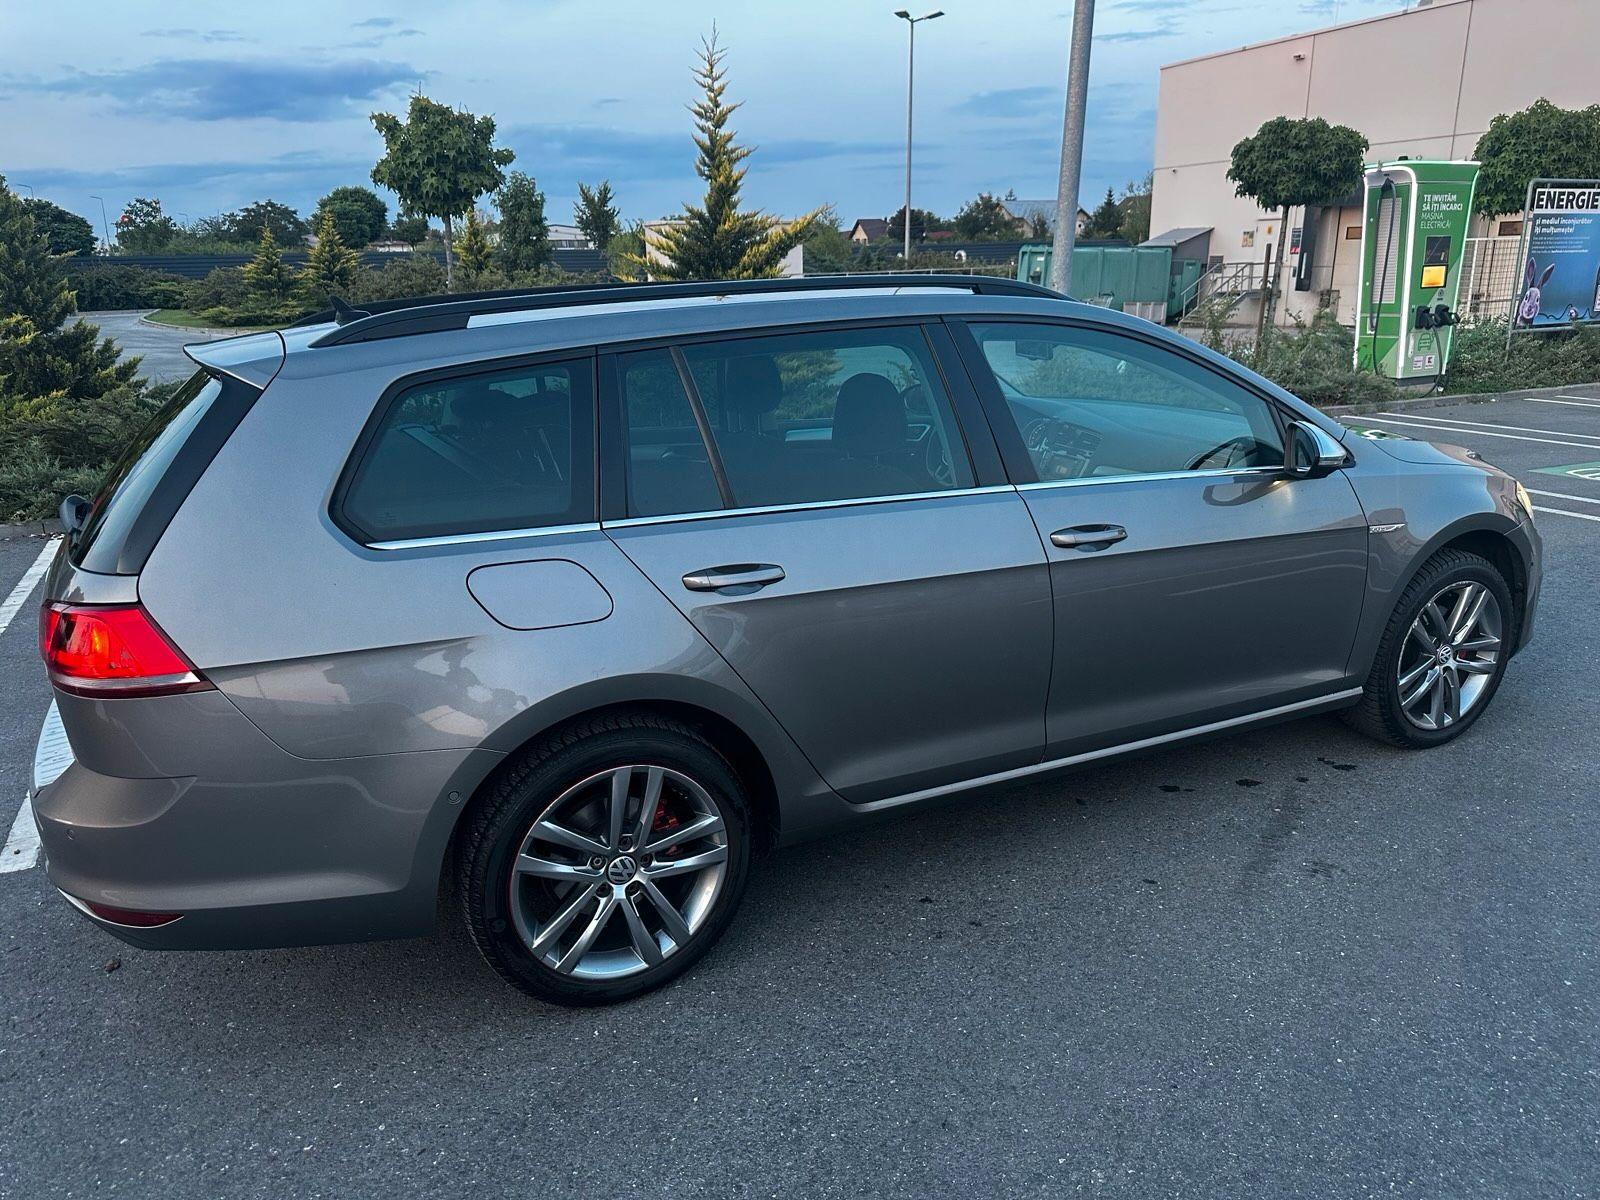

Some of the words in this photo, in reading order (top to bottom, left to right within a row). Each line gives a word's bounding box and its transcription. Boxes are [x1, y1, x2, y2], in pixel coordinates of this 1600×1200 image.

[1424, 194, 1431, 202] TE
[1432, 192, 1457, 202] INVITĂM
[1535, 190, 1600, 210] ENERGIE
[1422, 202, 1430, 211] SĂ
